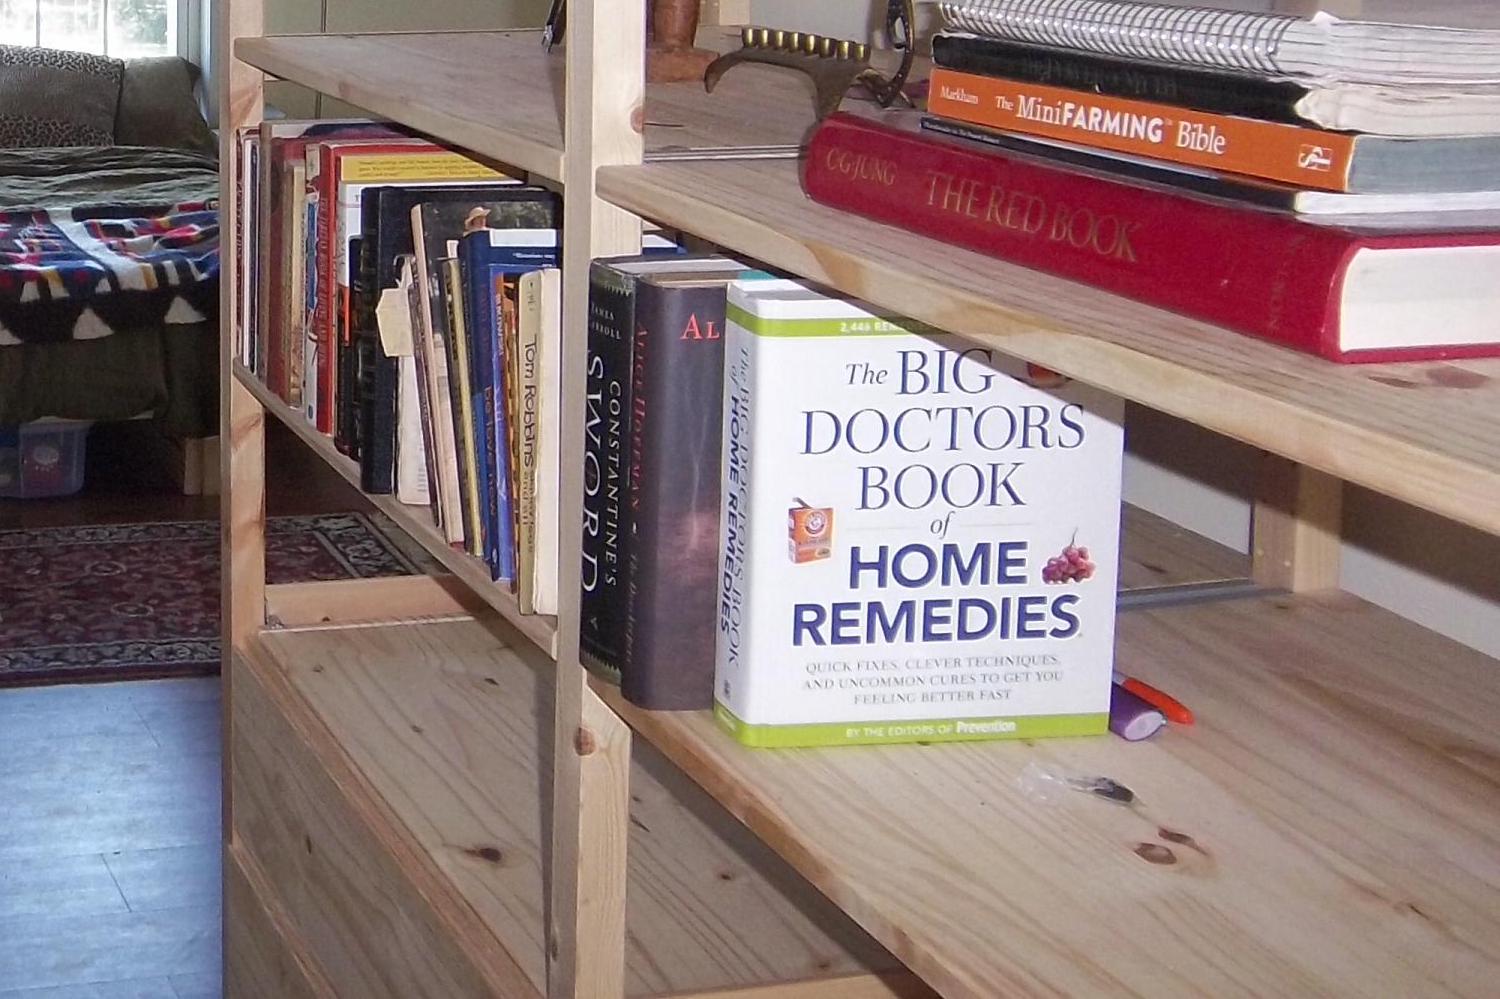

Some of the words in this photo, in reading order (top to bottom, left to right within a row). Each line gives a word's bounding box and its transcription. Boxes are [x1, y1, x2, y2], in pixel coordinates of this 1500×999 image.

[939, 84, 979, 105] Markham
[995, 95, 1015, 111] The
[1176, 120, 1227, 155] Bible
[926, 170, 982, 219] THE
[985, 184, 1046, 234] RED
[1049, 202, 1143, 263] BOOK
[524, 333, 538, 379] Tom
[634, 322, 648, 388] ALICE
[729, 364, 739, 387] of
[739, 347, 750, 383] The
[845, 362, 888, 386] The
[896, 347, 997, 396] BIG
[523, 384, 537, 467] Robbins
[738, 387, 750, 435] BIG
[799, 402, 1086, 455] DOCTORS
[630, 396, 646, 511] HOFFMAN
[729, 395, 740, 484] HOME
[580, 355, 604, 592] SWORD
[604, 380, 622, 587] CONSTANTINE'S
[855, 462, 1027, 511] BOOK
[733, 444, 749, 580] DOCTORS
[929, 510, 955, 539] of
[720, 491, 739, 635] REMEDIES
[849, 541, 1029, 589] HOME
[727, 587, 743, 669] BOOK
[792, 594, 1082, 646] REMEDIES
[803, 678, 835, 690] AND
[839, 676, 925, 689] UNCOMMON
[929, 674, 977, 686] CURES
[981, 673, 1000, 684] TO
[1003, 672, 1031, 684] GET
[1036, 670, 1064, 682] YOU
[806, 661, 851, 674] QUICK
[905, 657, 963, 670] CLEVER
[853, 693, 916, 705] FEELING
[921, 691, 975, 703] BETTER
[980, 689, 1013, 701] FAST
[845, 727, 860, 738] BY
[863, 726, 884, 738] THE
[888, 725, 935, 737] EDITORS
[938, 724, 954, 735] OF
[955, 719, 1017, 734] Prevention
